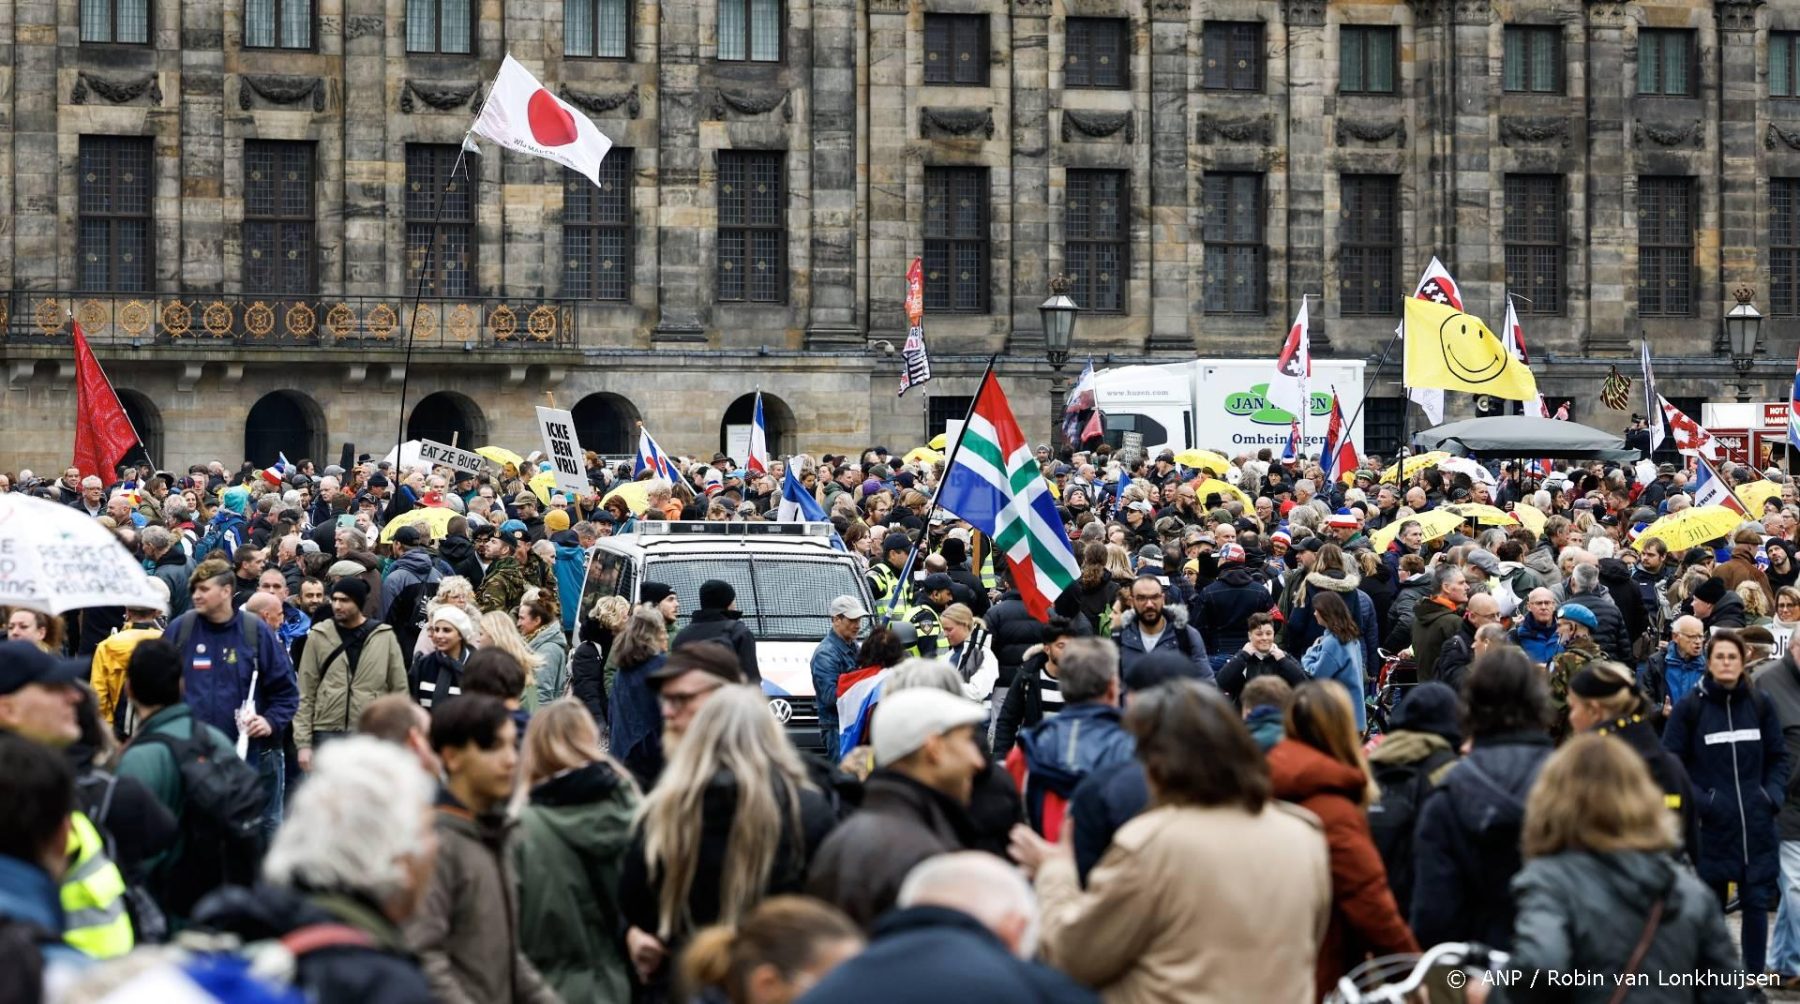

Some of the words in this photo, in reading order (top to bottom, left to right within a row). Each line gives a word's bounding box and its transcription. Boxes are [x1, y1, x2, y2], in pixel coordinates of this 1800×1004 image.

[1231, 397, 1264, 410] JAN
[1769, 407, 1784, 415] HOT
[546, 421, 570, 440] ICKE
[420, 443, 440, 459] EAT
[438, 449, 456, 464] ZE
[457, 453, 482, 472] BUGZ
[551, 439, 573, 458] BEN
[554, 456, 578, 475] VRIJ
